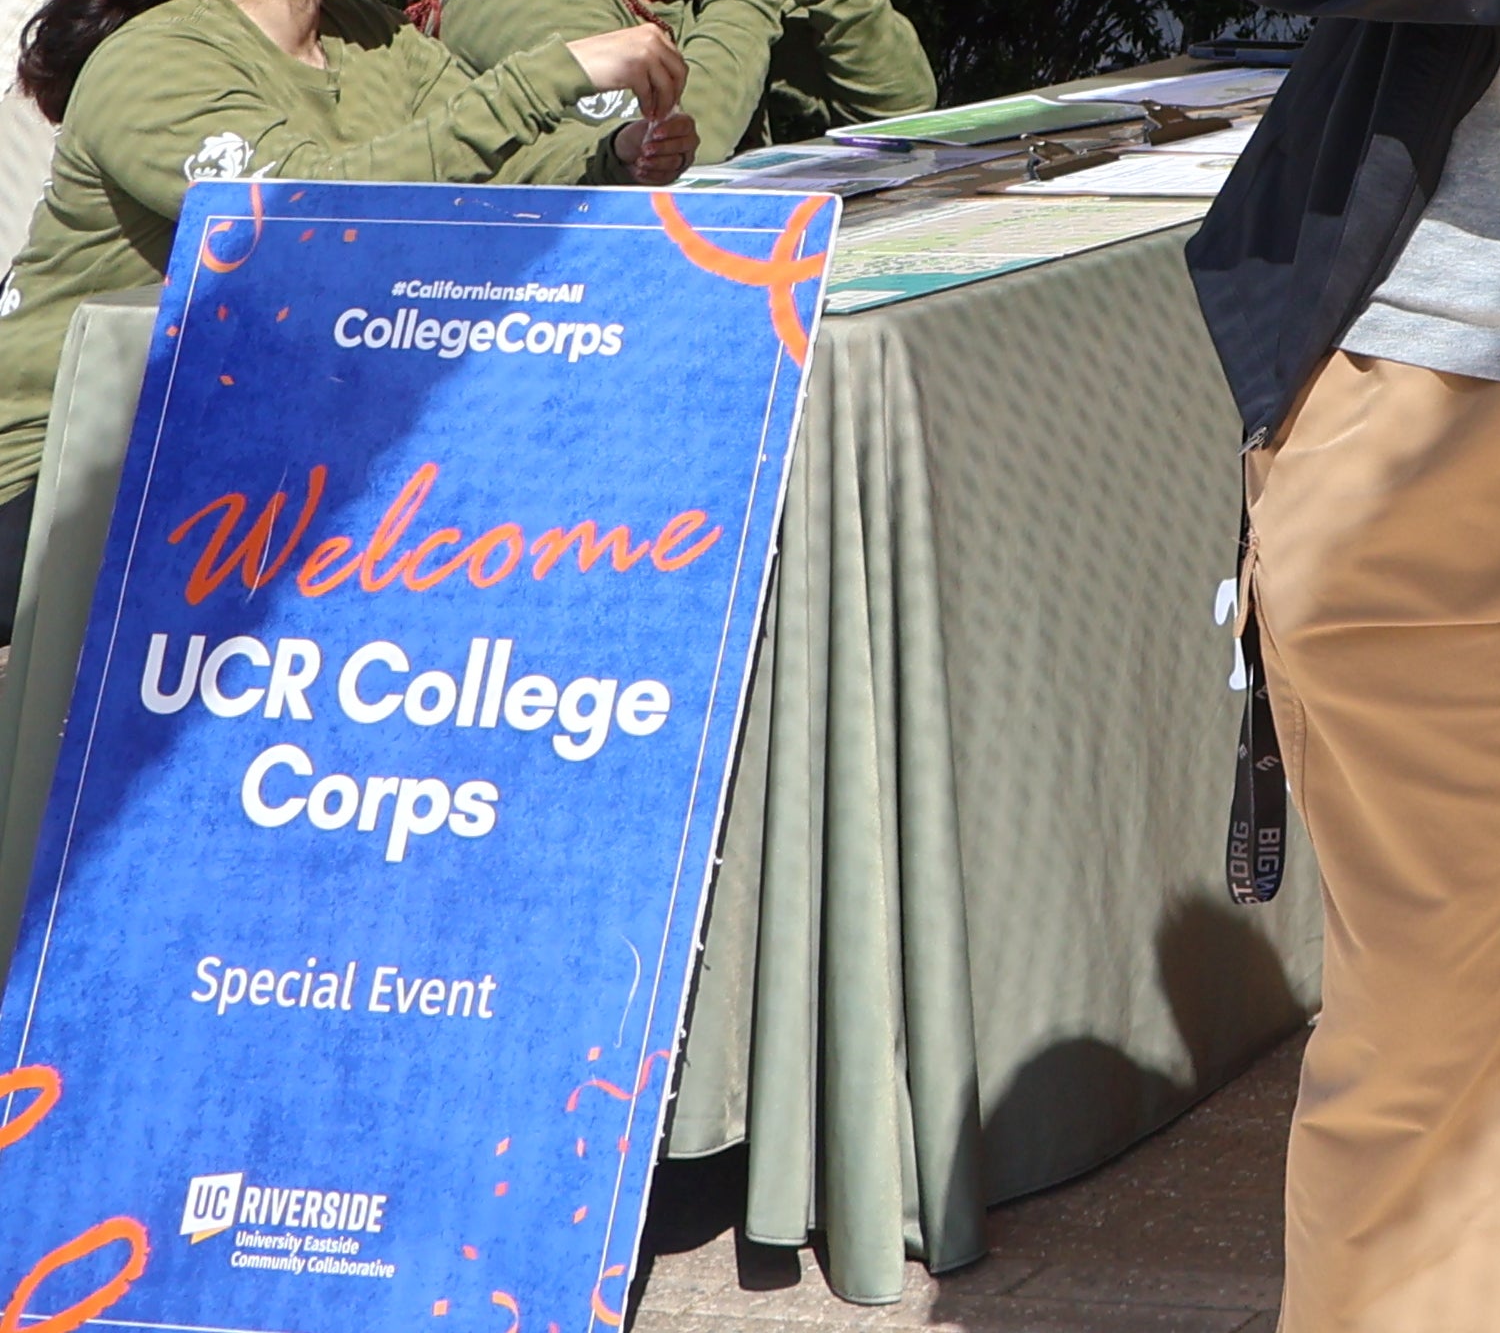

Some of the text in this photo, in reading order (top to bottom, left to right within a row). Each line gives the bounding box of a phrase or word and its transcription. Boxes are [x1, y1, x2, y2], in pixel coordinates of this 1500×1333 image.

[391, 279, 587, 304] #CaliforniansForAll
[333, 307, 625, 363] CollegeCorps
[167, 461, 724, 606] Welcome
[139, 632, 671, 762] UCR College
[240, 744, 499, 862] Corps
[190, 955, 497, 1023] Special Event
[193, 1184, 388, 1233] UC RIVERSIDE
[231, 1251, 396, 1279] Community Collaborative
[235, 1230, 360, 1255] University Eastside
